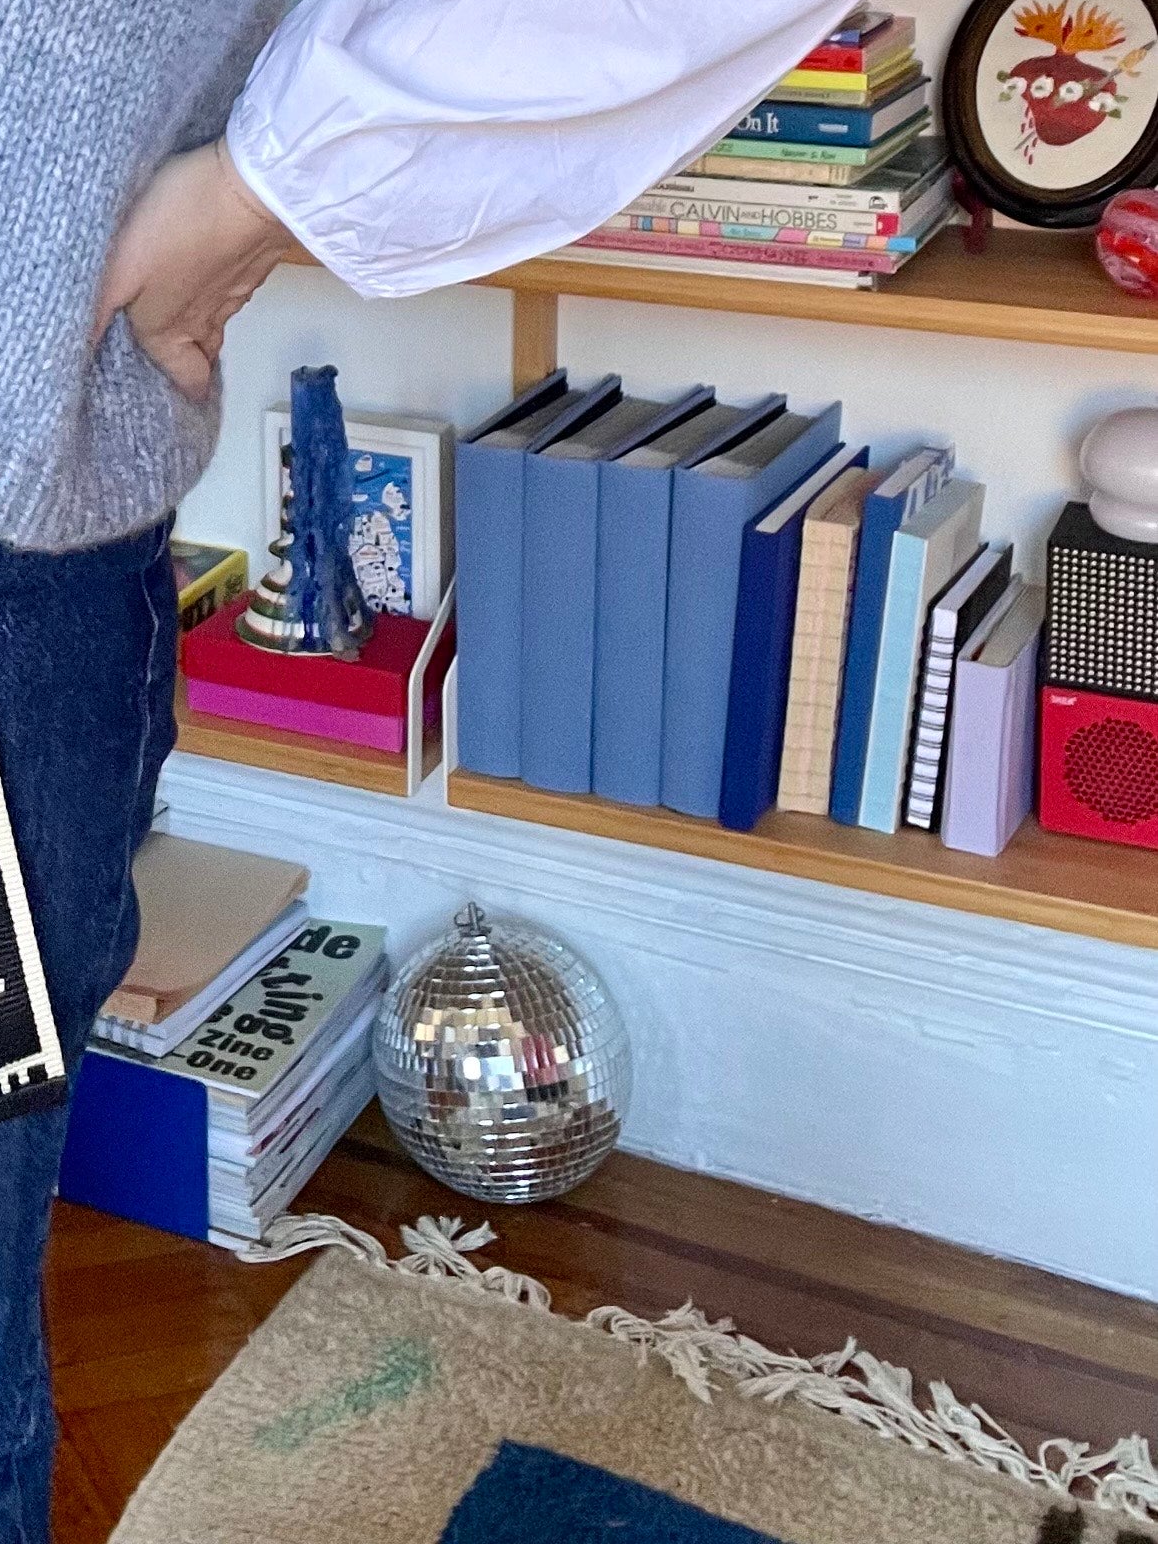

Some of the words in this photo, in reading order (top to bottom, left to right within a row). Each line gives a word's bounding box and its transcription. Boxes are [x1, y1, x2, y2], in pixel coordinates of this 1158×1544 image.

[766, 112, 779, 133] It
[669, 201, 741, 222] CALVIN
[761, 208, 838, 231] HOBBES
